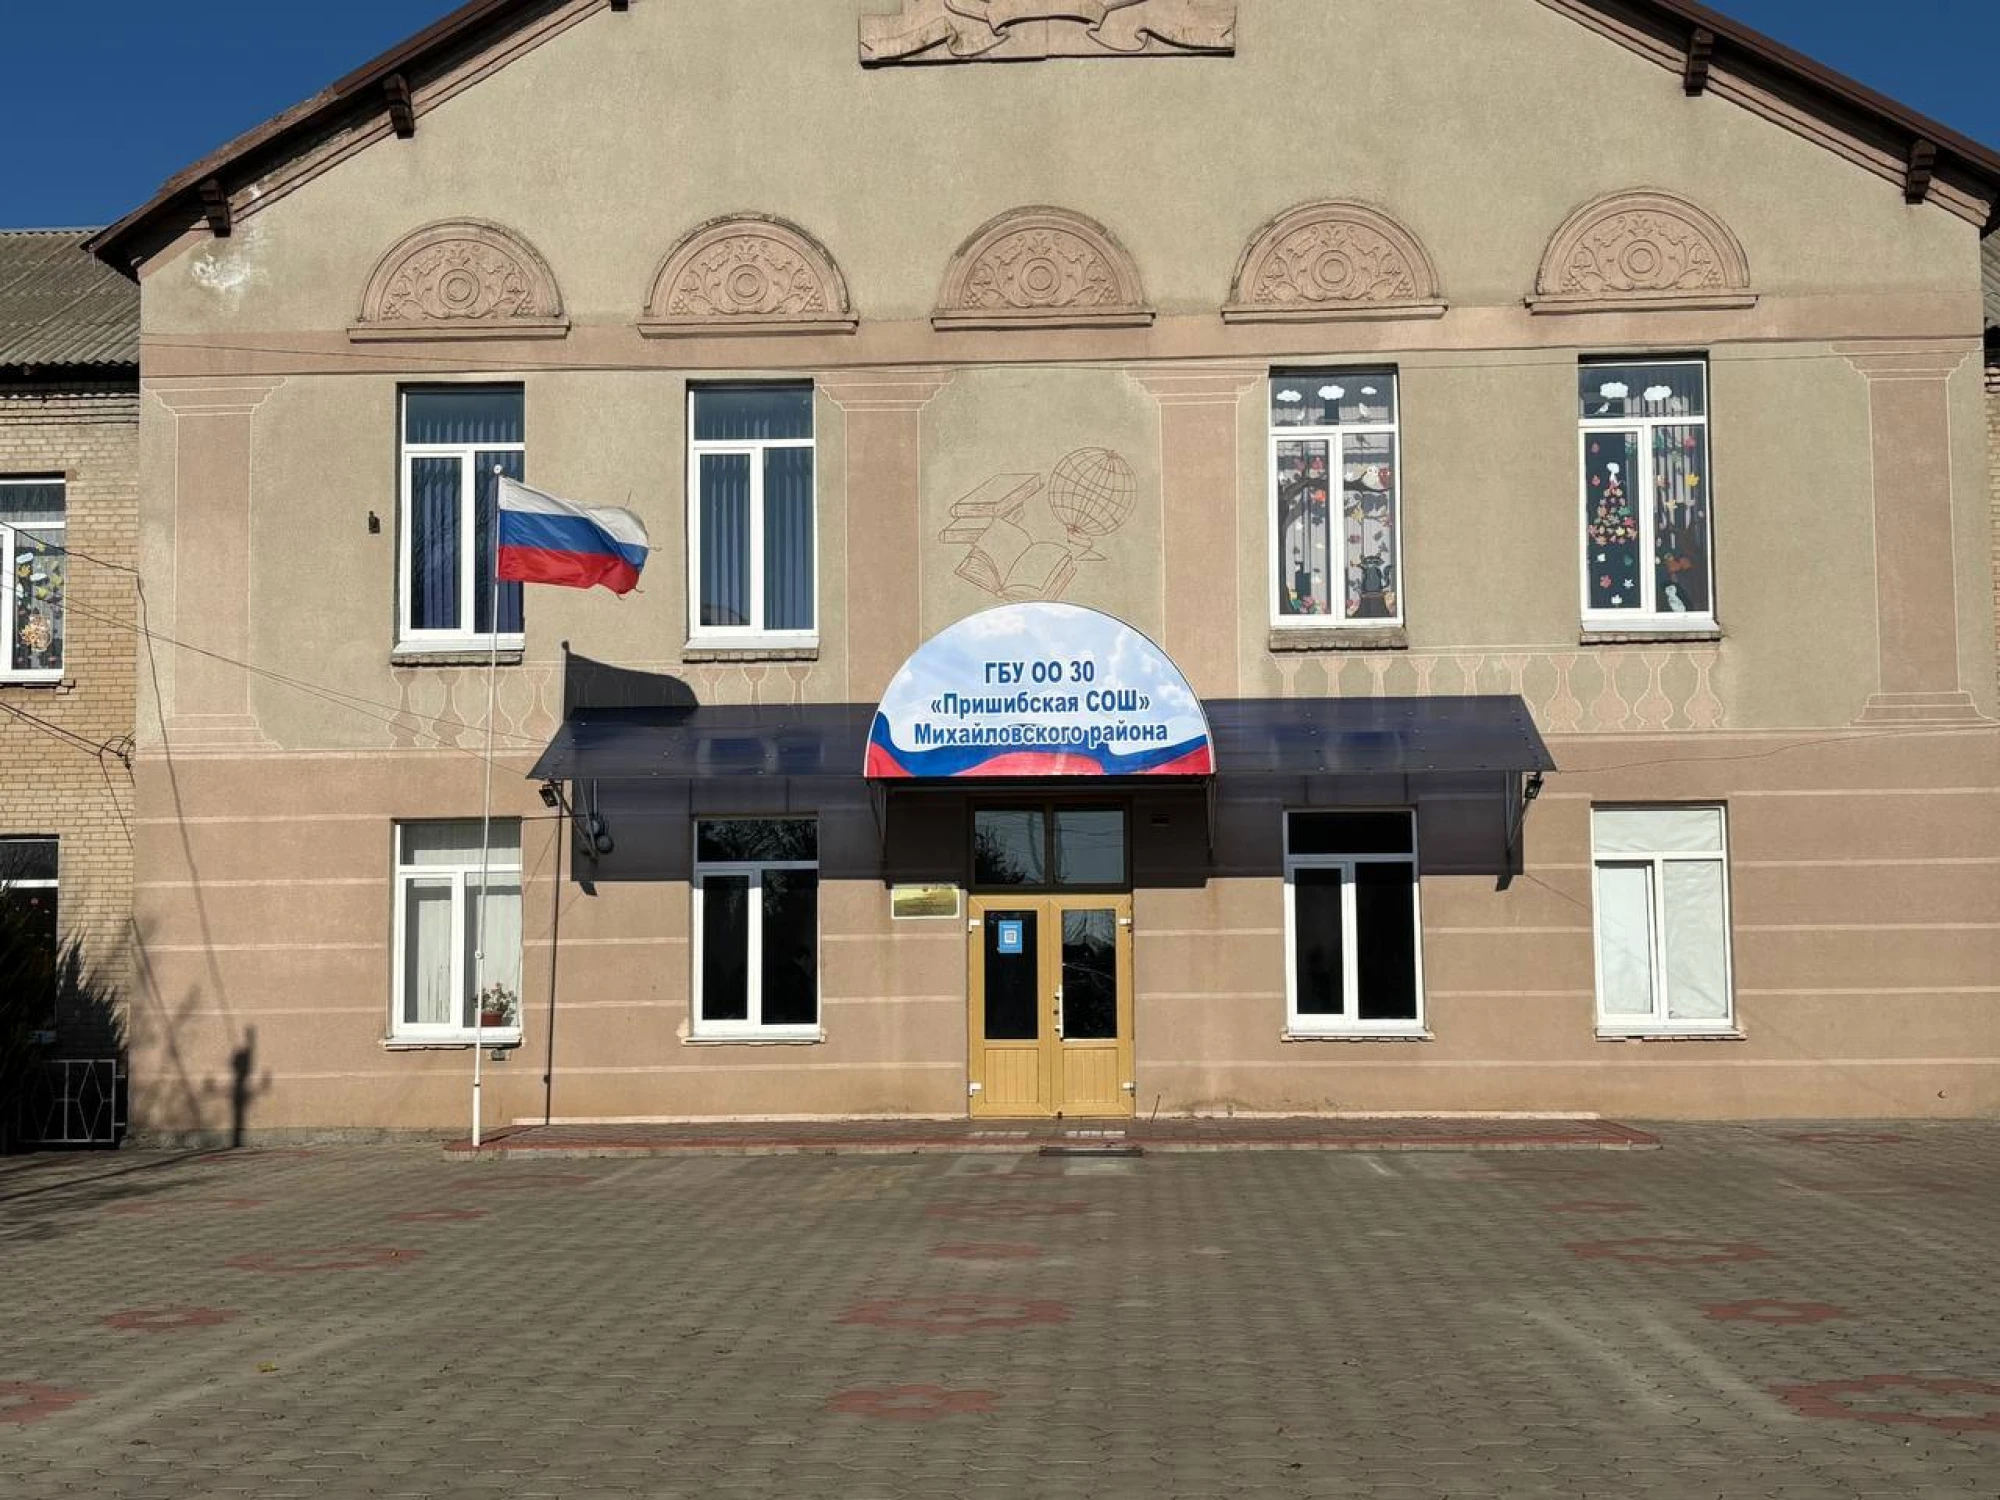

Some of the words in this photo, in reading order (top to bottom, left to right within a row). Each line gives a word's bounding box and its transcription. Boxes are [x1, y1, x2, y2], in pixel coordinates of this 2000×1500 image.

[985, 662, 1024, 684] ГБУ
[1032, 661, 1064, 683] ОО
[1070, 660, 1095, 682] 30
[930, 692, 1079, 719] «Пришибская
[1085, 690, 1151, 712] СОШ»
[914, 722, 1082, 745] Михайловского
[1089, 720, 1168, 747] района
